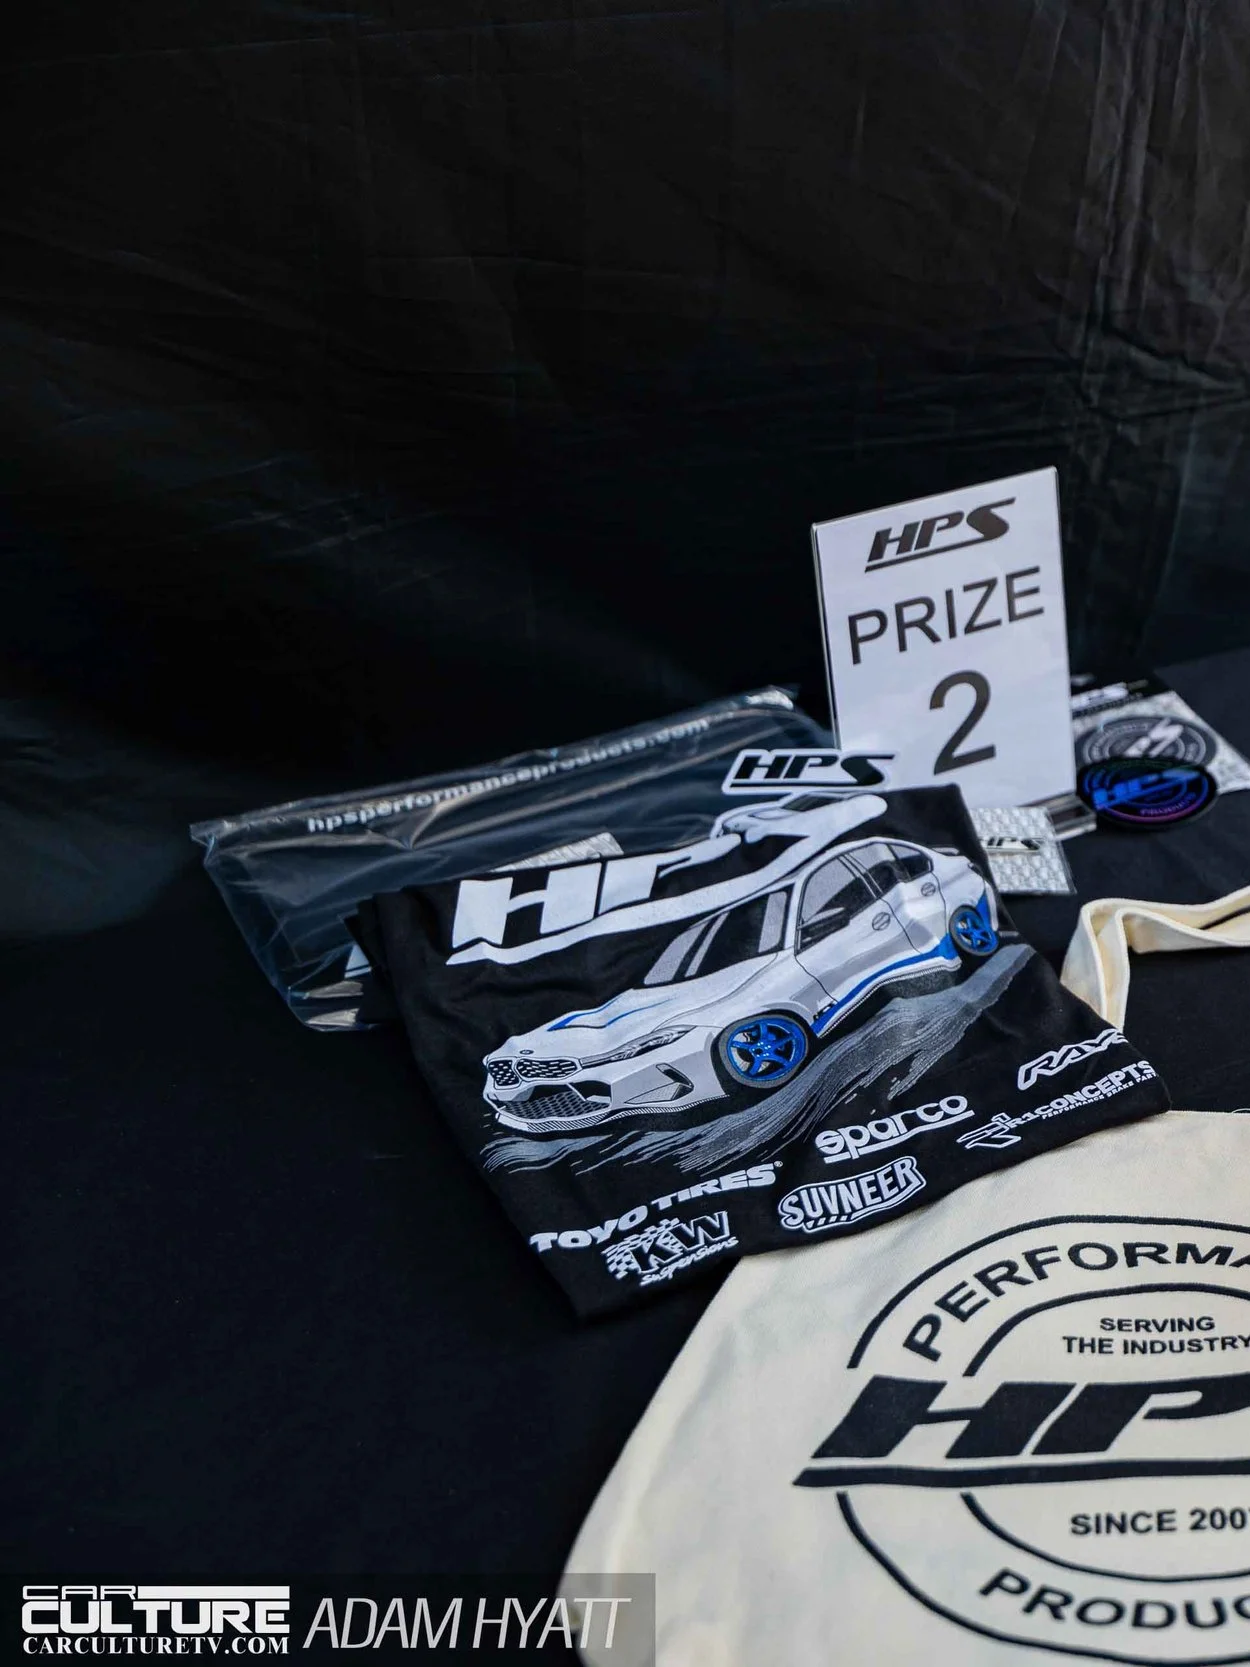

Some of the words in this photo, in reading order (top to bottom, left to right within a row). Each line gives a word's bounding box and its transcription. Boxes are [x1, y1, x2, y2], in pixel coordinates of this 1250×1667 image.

[865, 497, 1017, 573] HPS
[847, 566, 1045, 665] PRIZE
[929, 670, 997, 775] 2
[306, 717, 710, 833] hpsperformanceproducts.com
[729, 753, 896, 789] HPS
[1042, 1094, 1105, 1120] PERFORMANCE
[1107, 1082, 1134, 1098] BRAKE
[1136, 1072, 1159, 1083] PART
[815, 1095, 973, 1163] sparco
[782, 1159, 916, 1227] SUVNEER
[529, 1205, 648, 1252] TOYO
[625, 1210, 730, 1275] KW
[1062, 1335, 1114, 1355] THE
[1099, 1315, 1216, 1334] SERVING
[1070, 1509, 1178, 1537] SINCE
